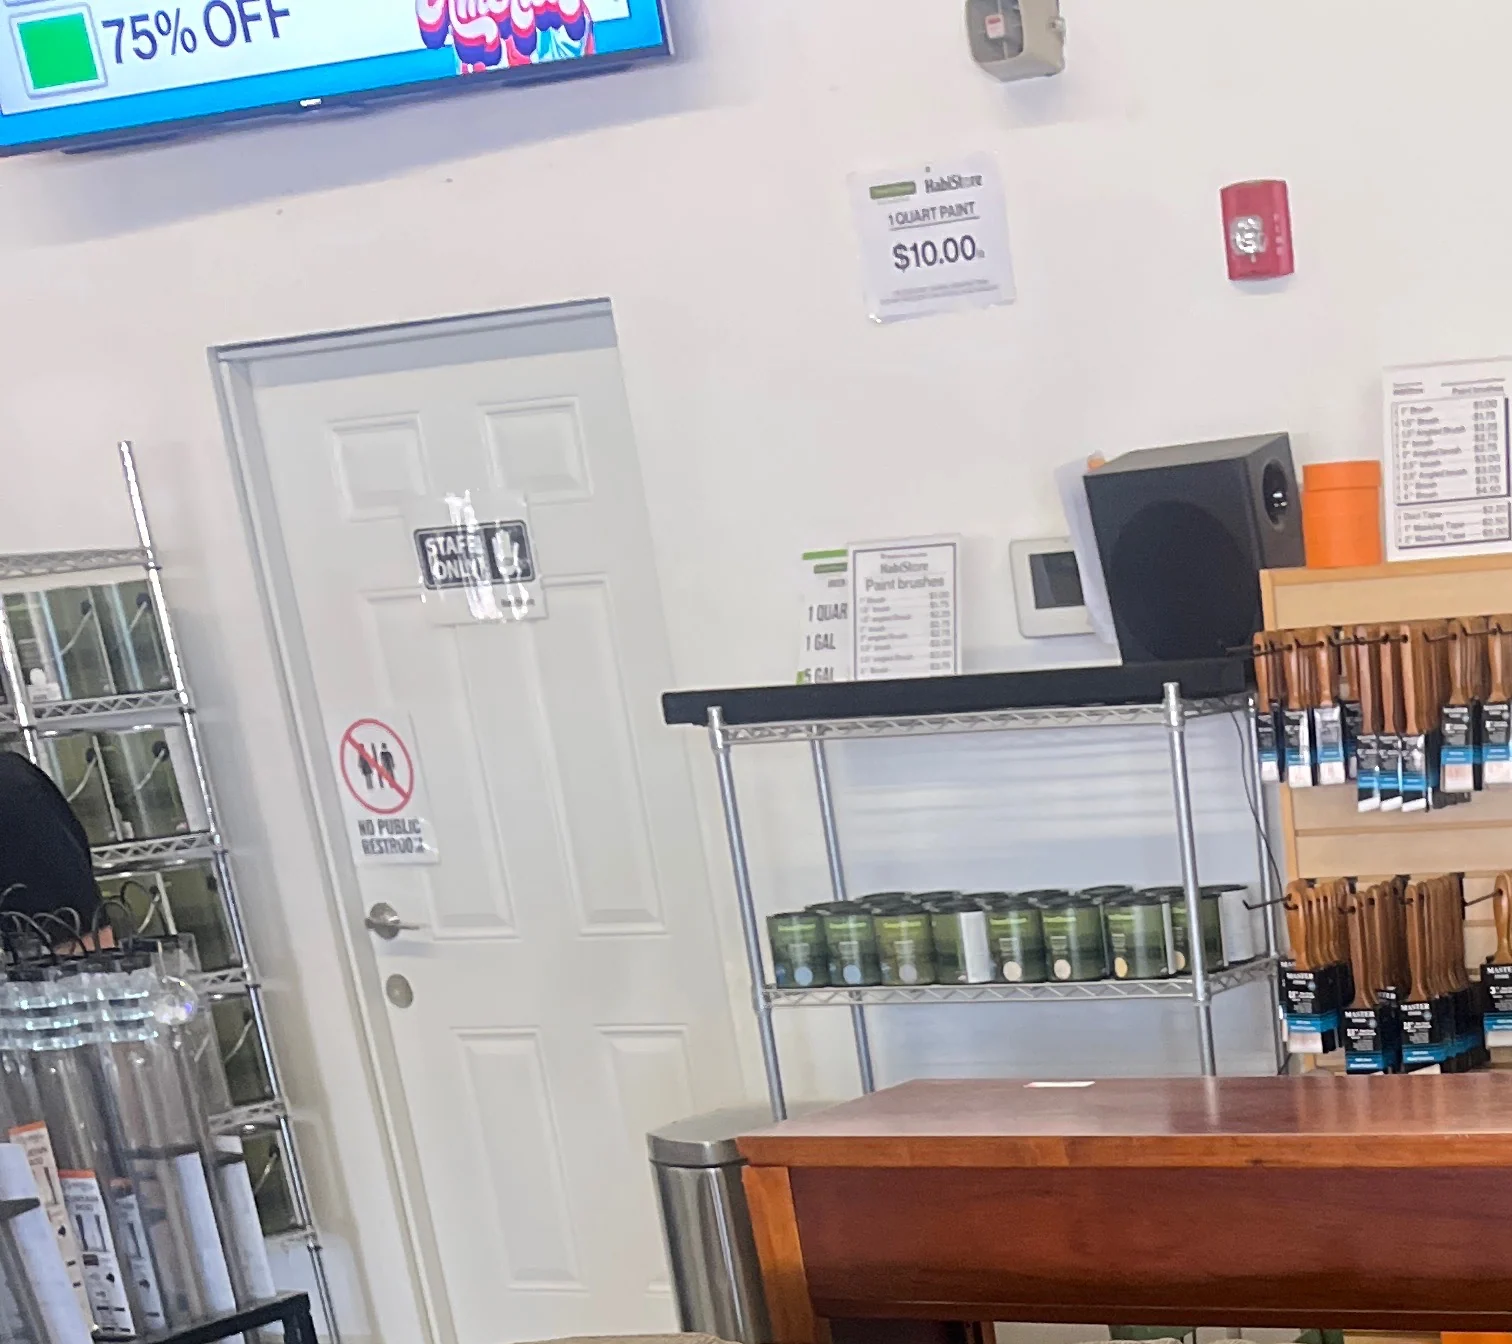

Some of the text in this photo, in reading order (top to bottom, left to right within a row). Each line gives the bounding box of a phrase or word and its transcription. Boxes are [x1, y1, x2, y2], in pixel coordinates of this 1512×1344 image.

[102, 0, 290, 64] 75% OFF
[889, 202, 976, 226] 1 QUART PAINT
[893, 235, 976, 273] $10.00
[865, 575, 945, 592] Paint brushes
[808, 602, 848, 622] 1 QUAR
[806, 633, 836, 651] 1 GAL
[357, 818, 421, 836] NO PUBLIC
